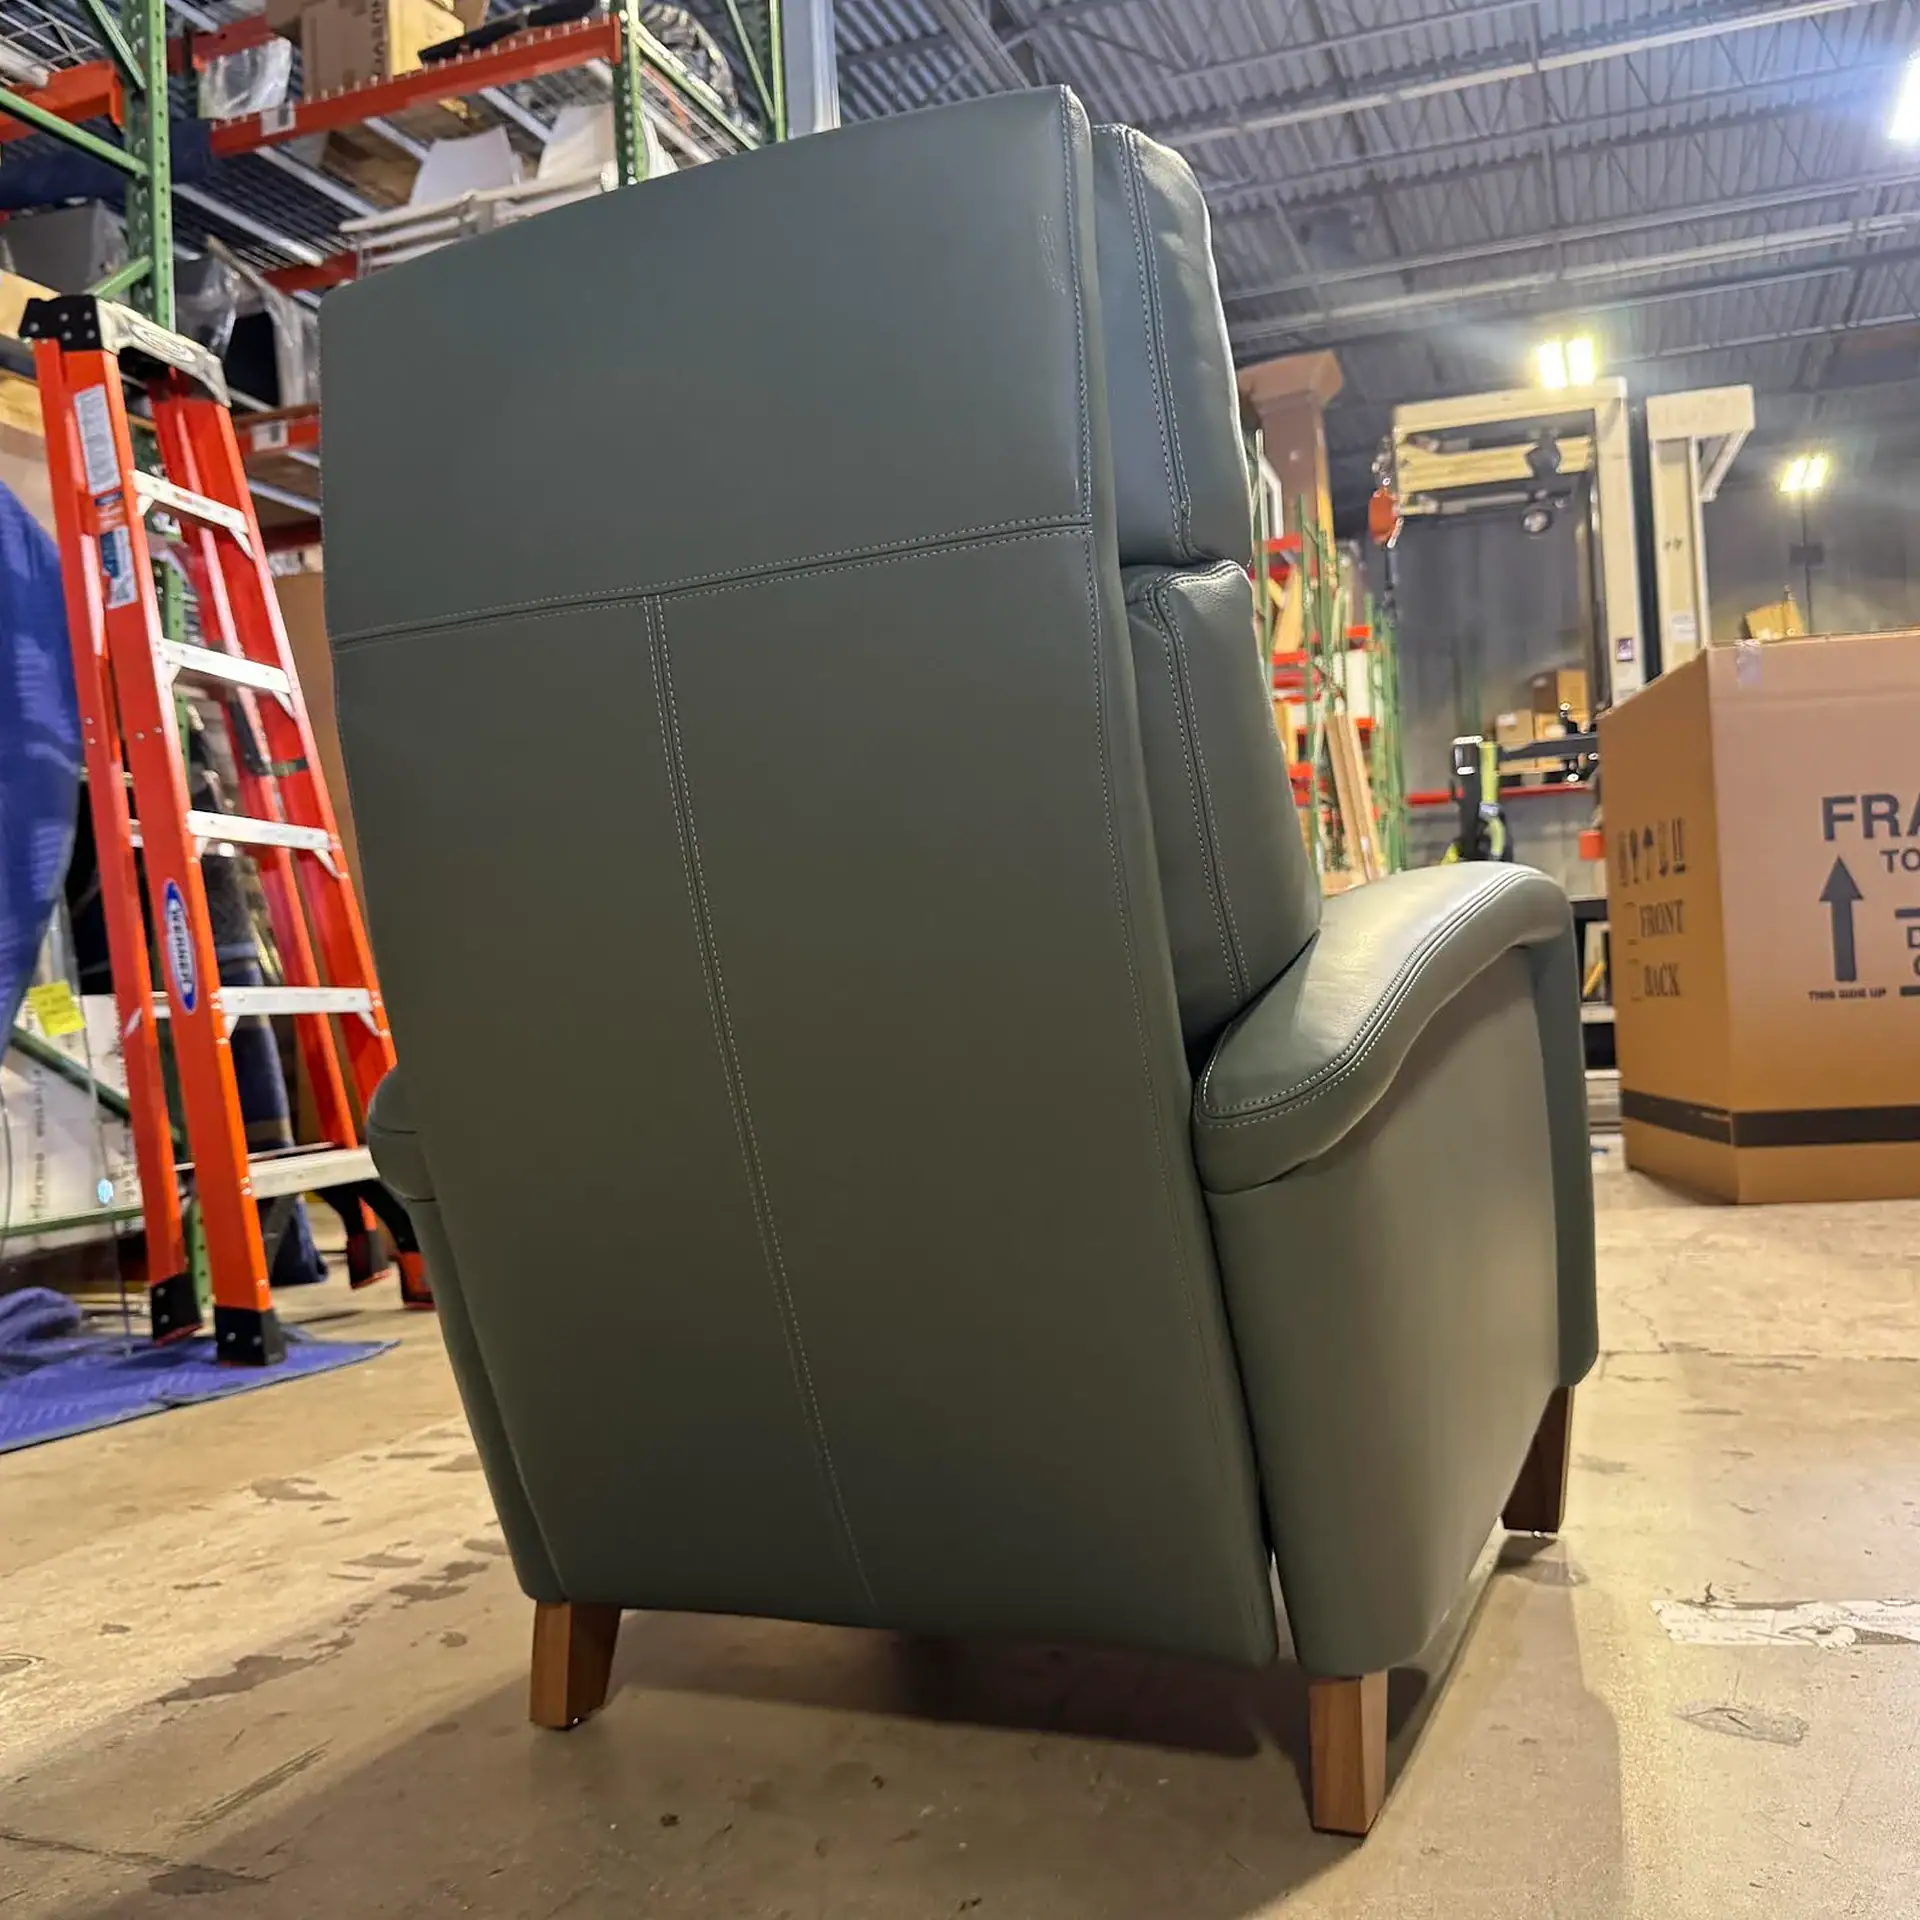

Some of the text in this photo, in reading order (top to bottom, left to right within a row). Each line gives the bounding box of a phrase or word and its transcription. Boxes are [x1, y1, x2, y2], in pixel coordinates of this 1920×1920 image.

[1639, 899, 1684, 938] FRONT
[1644, 962, 1681, 997] BACK
[1808, 987, 1887, 1000] THIS SIDE UP
